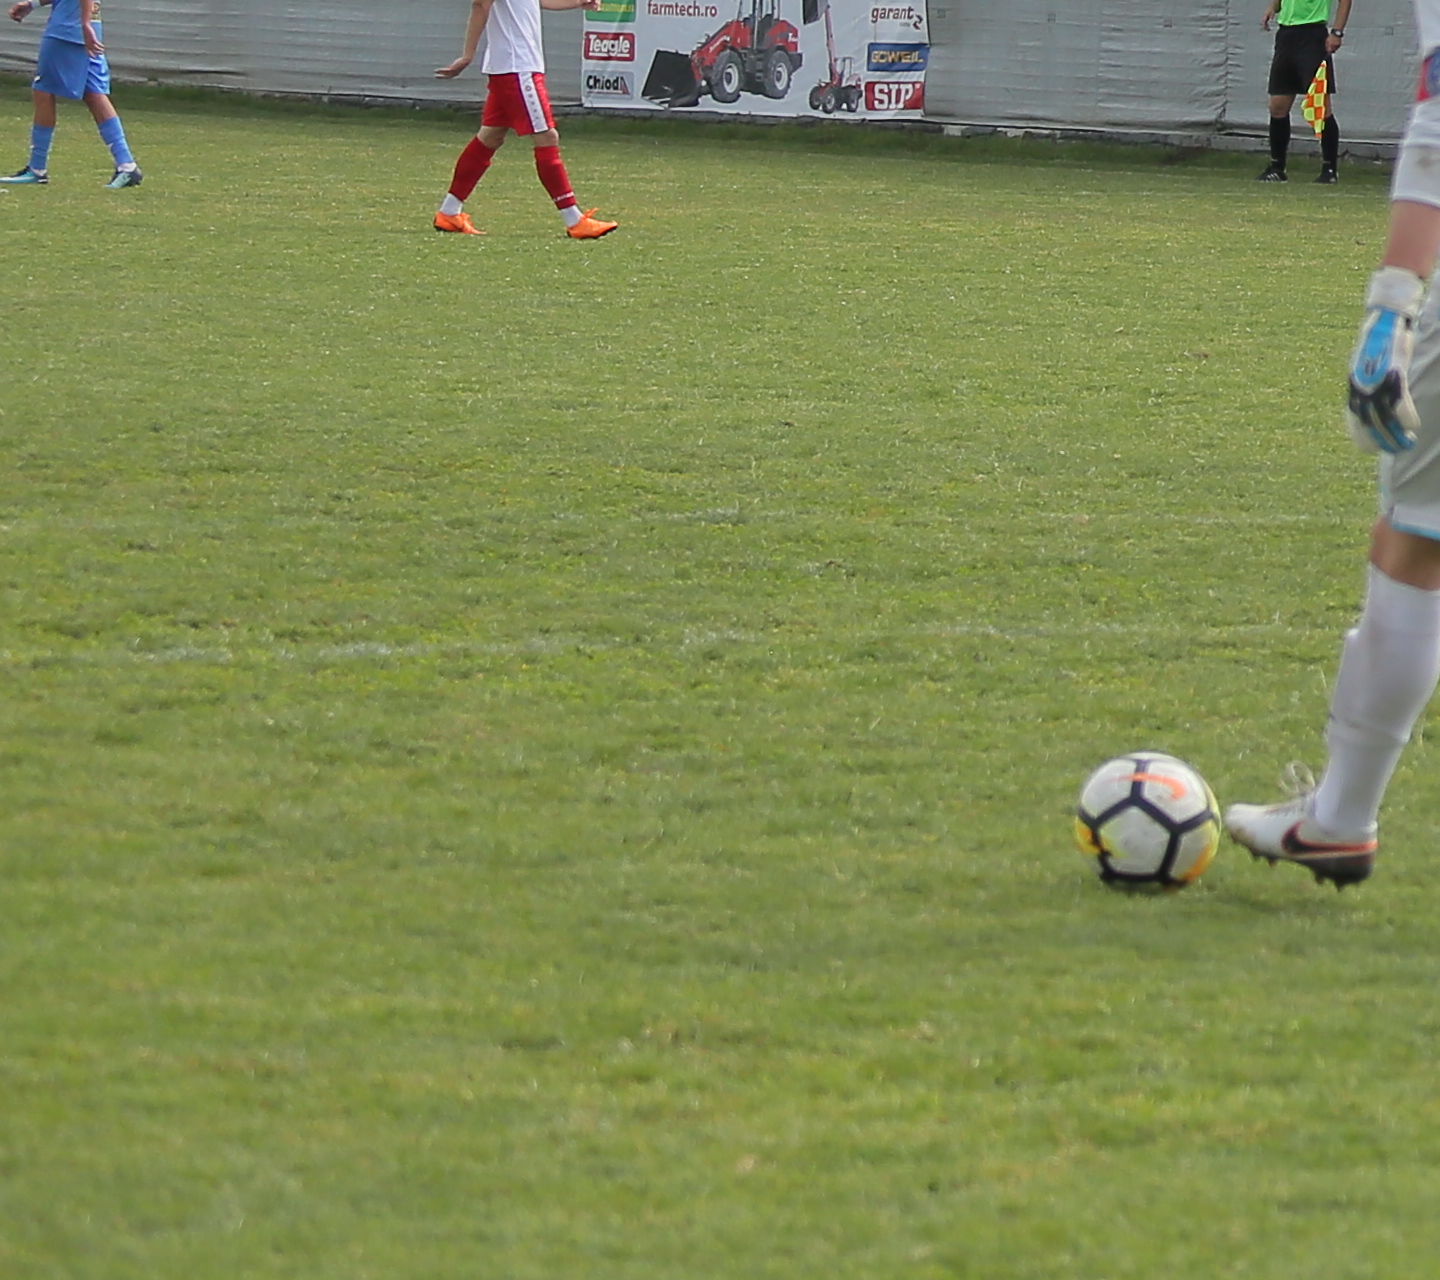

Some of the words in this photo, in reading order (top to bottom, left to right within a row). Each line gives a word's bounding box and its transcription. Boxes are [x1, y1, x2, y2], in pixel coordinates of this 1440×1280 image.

[870, 6, 914, 23] garant
[588, 34, 631, 57] Teagle
[873, 83, 914, 110] SIP
